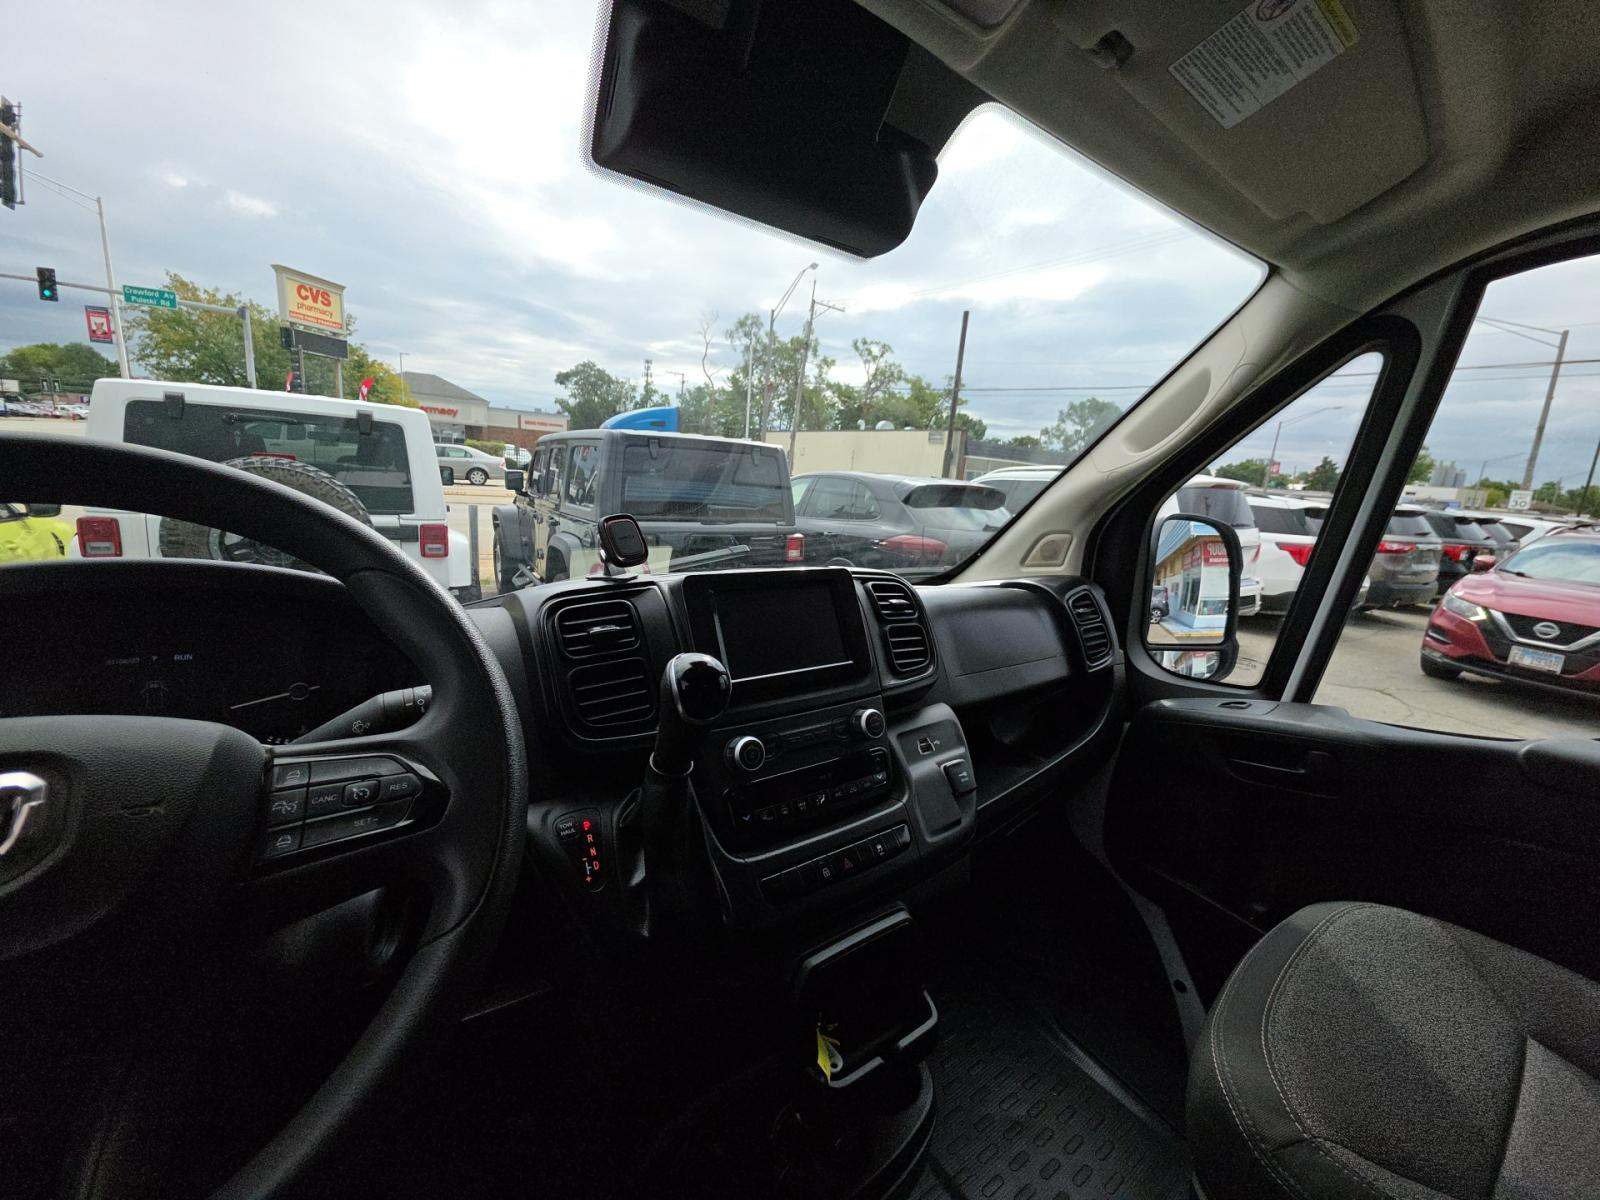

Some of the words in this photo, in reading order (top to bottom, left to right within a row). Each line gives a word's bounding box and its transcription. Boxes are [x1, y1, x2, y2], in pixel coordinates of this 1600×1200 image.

[124, 287, 159, 298] Crawford
[163, 292, 175, 300] Av
[296, 284, 332, 307] CVS
[160, 299, 171, 307] Rd
[296, 301, 334, 319] pharmacy
[174, 653, 193, 661] RUN
[389, 783, 408, 791] RES
[559, 822, 573, 830] TOW
[583, 820, 591, 831] P
[587, 834, 594, 843] R
[590, 847, 597, 856] N
[593, 860, 600, 871] D
